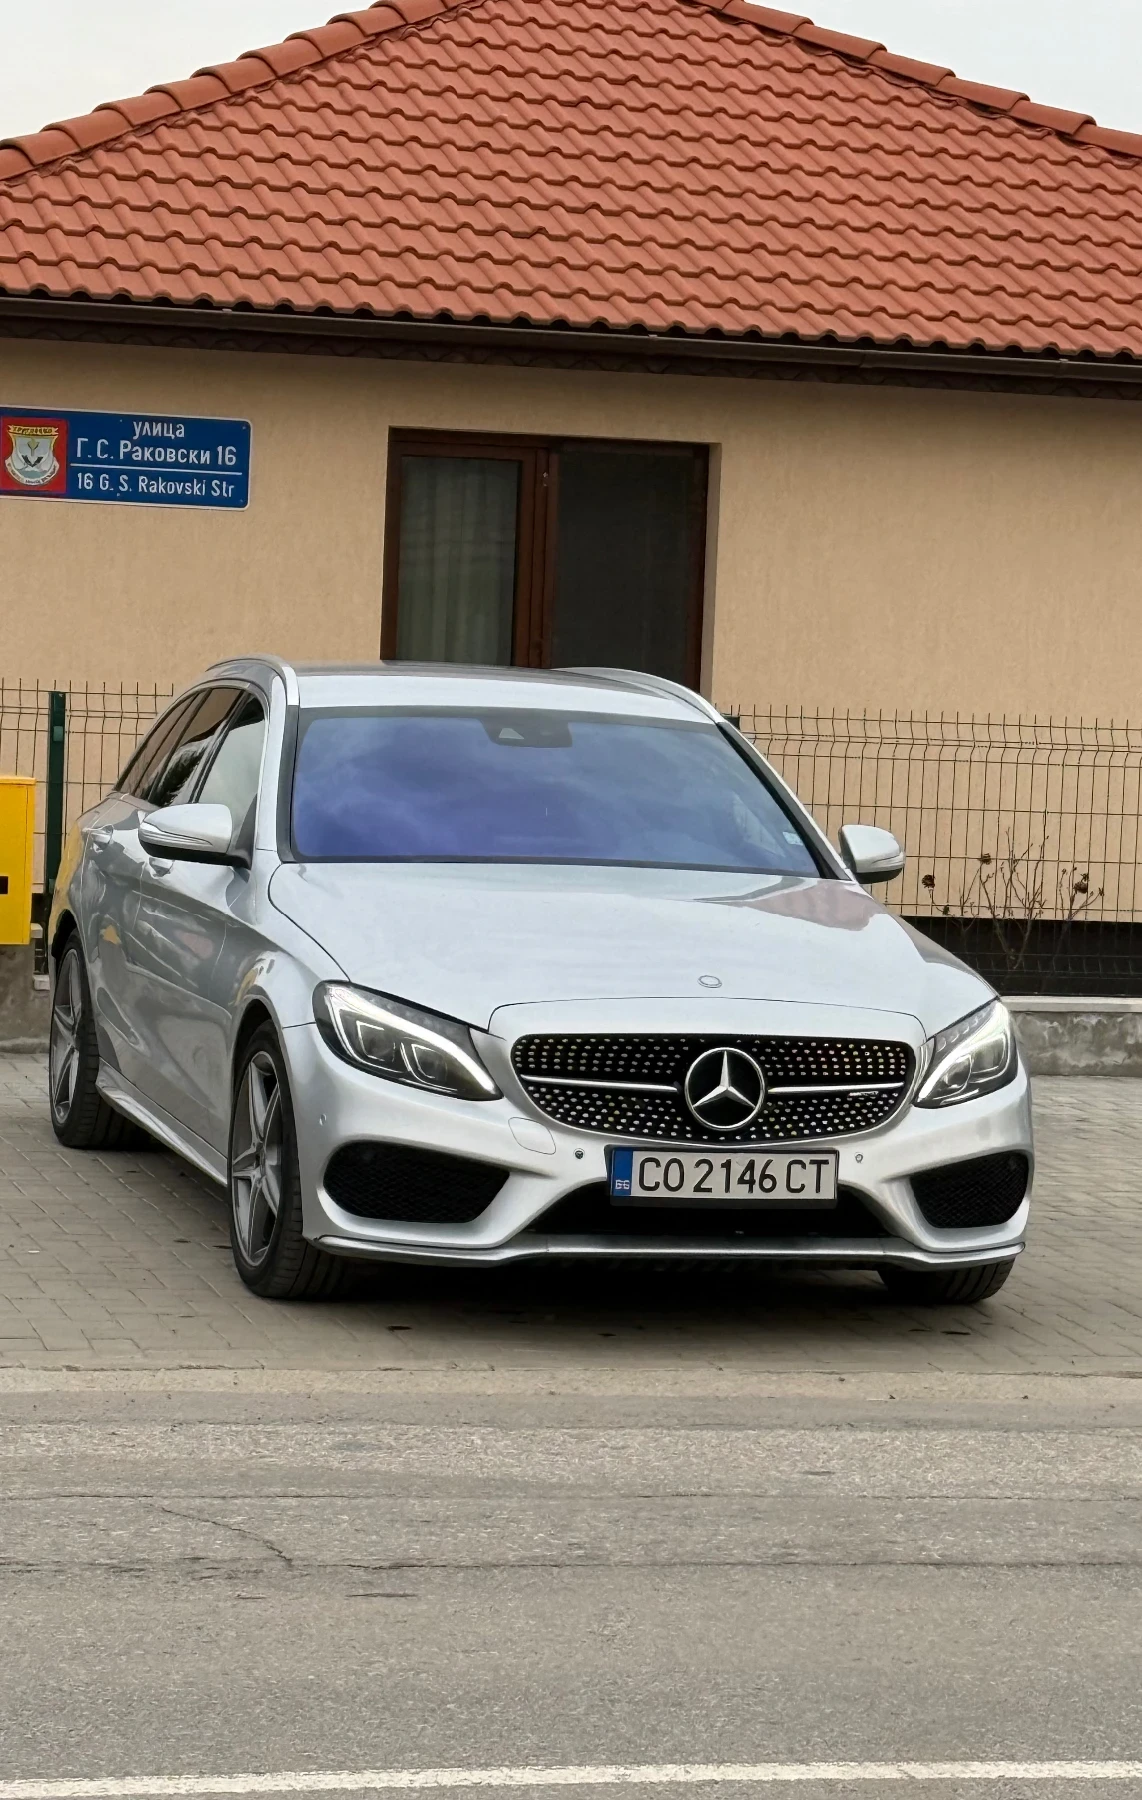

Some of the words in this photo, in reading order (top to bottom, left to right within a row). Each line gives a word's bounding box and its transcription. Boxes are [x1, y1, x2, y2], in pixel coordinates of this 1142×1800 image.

[133, 420, 185, 440] улица
[76, 437, 92, 458] Г.
[96, 439, 114, 460] С.
[119, 440, 211, 465] Раковски
[217, 446, 237, 466] 16
[77, 472, 94, 489] 16
[100, 474, 114, 491] G.
[118, 475, 132, 492] S.
[138, 475, 206, 496] Rakovski
[692, 1158, 778, 1194] 2146
